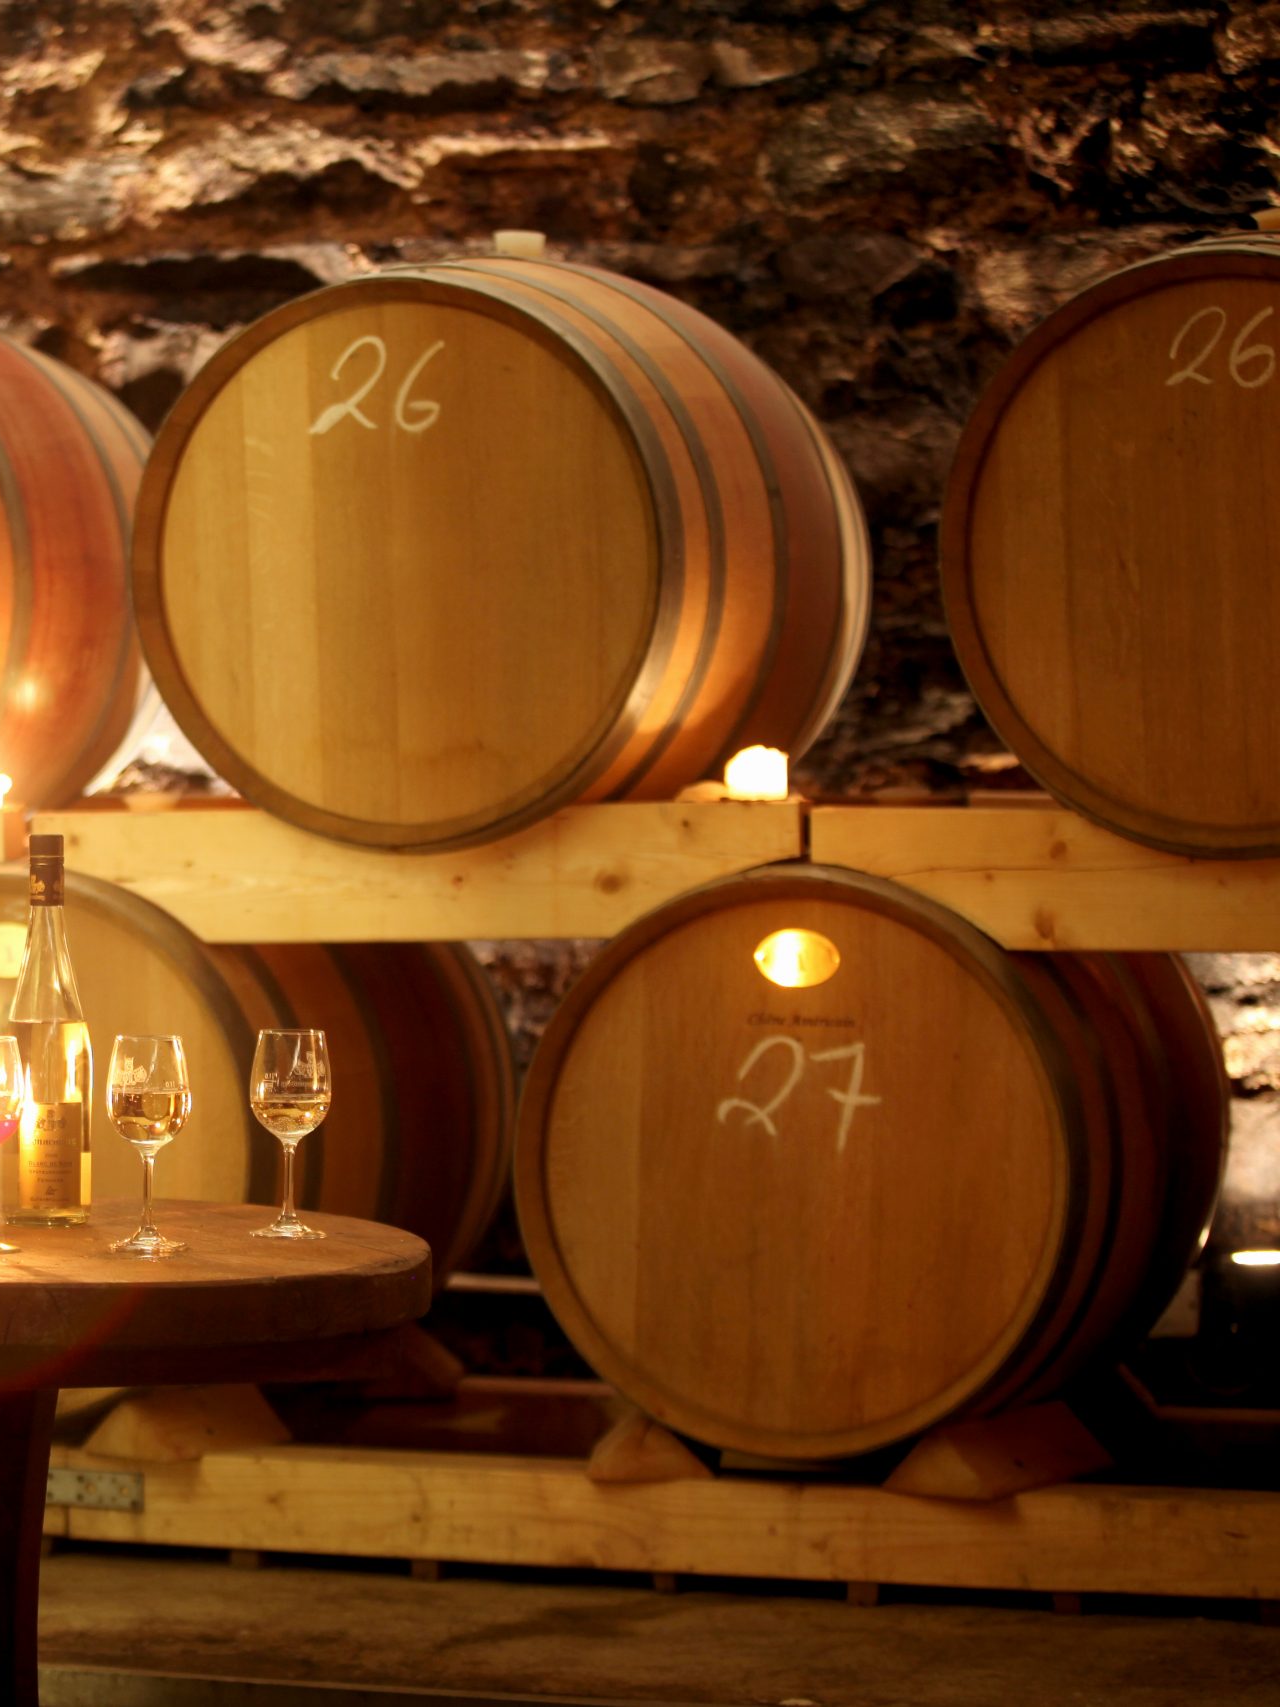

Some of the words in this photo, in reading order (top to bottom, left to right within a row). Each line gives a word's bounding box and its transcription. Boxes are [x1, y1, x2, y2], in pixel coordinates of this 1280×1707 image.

[308, 335, 445, 434] 26
[1165, 305, 1276, 388] 26
[716, 1035, 882, 1154] 27
